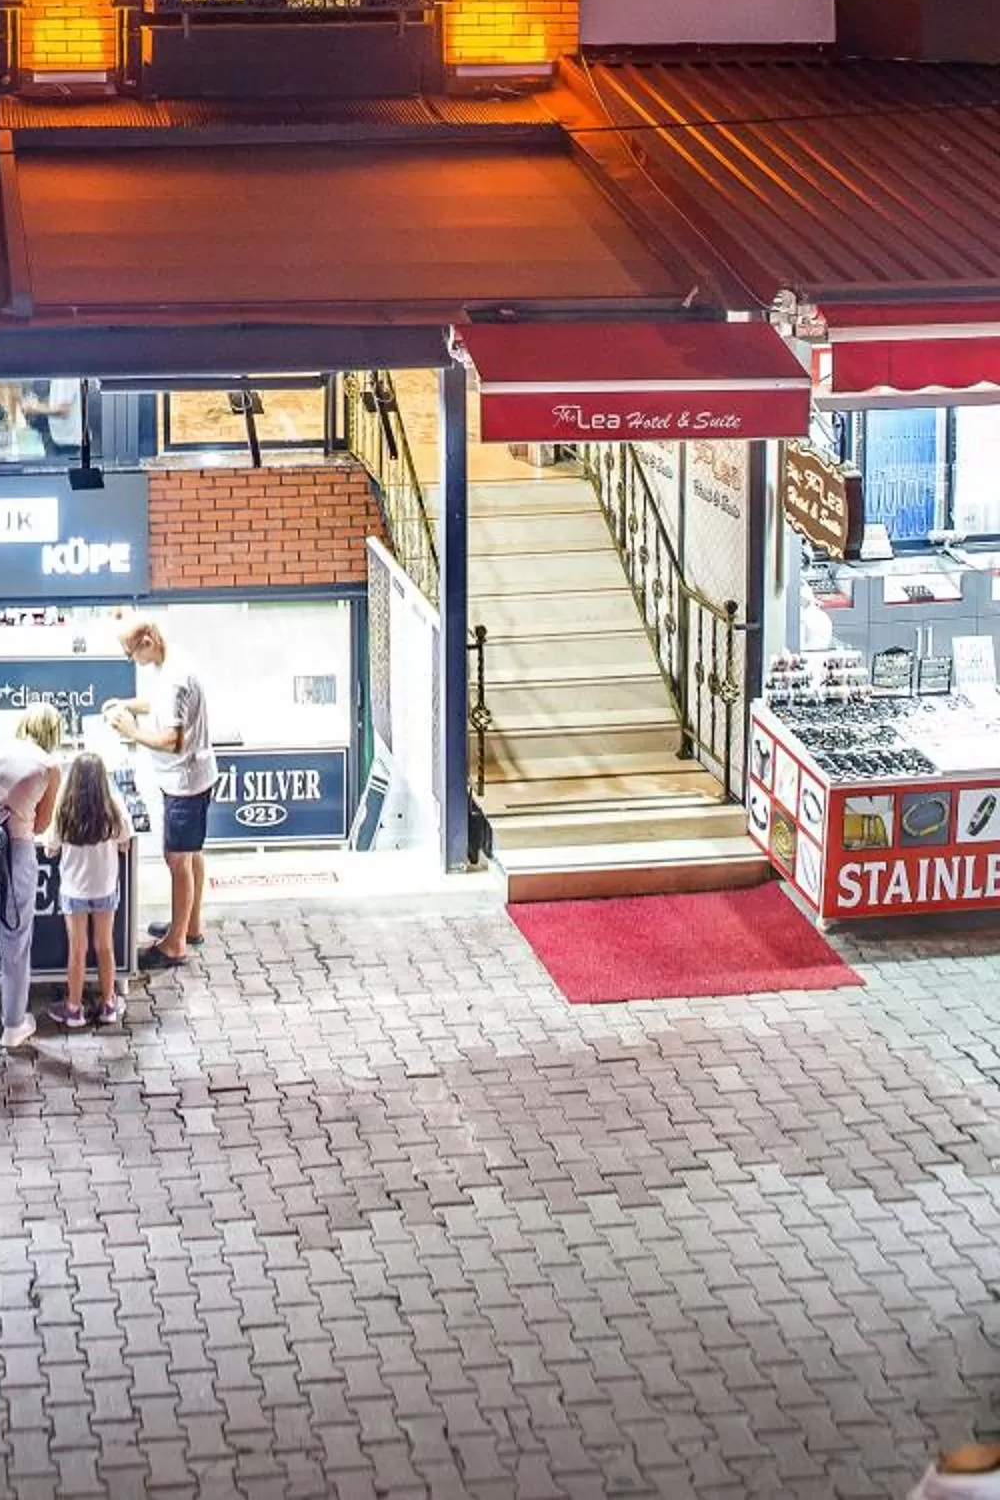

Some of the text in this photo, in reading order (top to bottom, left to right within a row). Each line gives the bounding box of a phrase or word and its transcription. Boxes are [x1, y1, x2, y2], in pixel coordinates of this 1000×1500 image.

[552, 405, 742, 430] The Lea Hotel & Suite
[41, 537, 132, 575] KÜPE
[212, 764, 321, 803] Zİ SILVER
[243, 807, 278, 822] 925
[838, 854, 1000, 908] STAINLE
